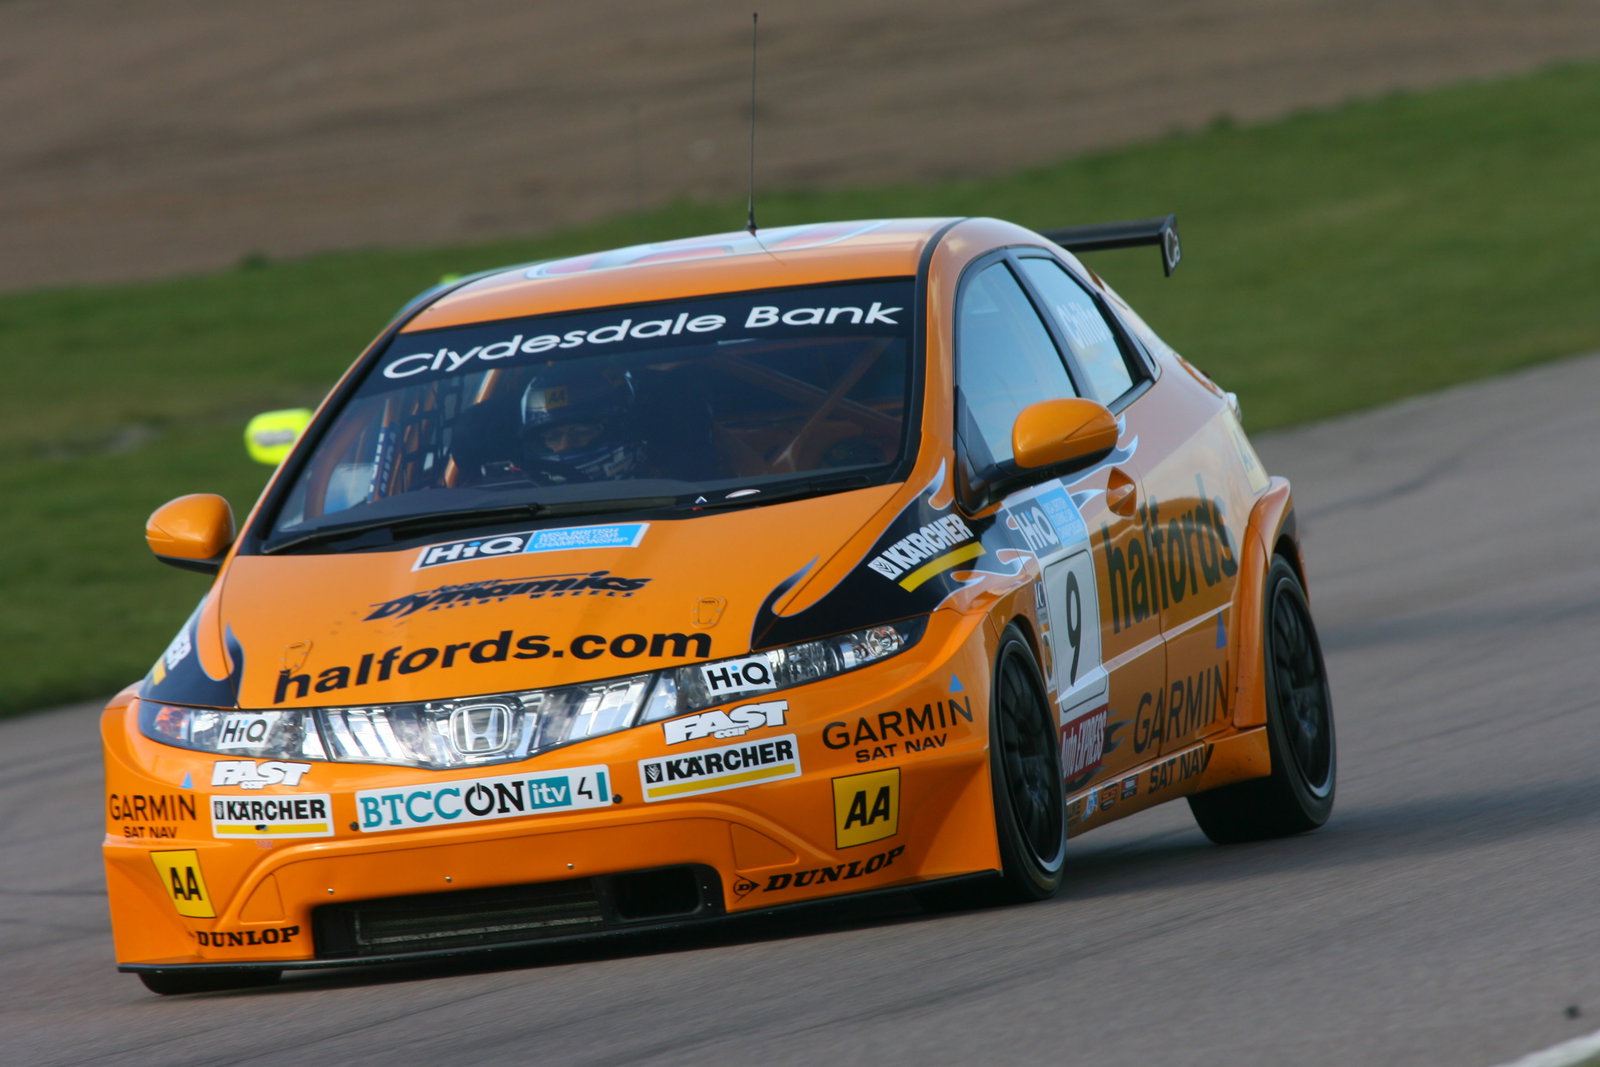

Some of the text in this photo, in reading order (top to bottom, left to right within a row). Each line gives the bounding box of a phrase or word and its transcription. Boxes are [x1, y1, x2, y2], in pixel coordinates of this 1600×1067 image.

[383, 302, 903, 379] Clydesdale Bank
[1014, 506, 1060, 551] HiQ
[425, 535, 524, 568] HiQ
[1101, 472, 1239, 634] halfords
[1066, 571, 1083, 688] 9
[273, 630, 713, 704] halfords.com
[707, 662, 771, 690] HiQ
[663, 700, 789, 745] FAST
[822, 696, 974, 750] GARMIN
[1134, 660, 1230, 754] GARMIN
[221, 719, 268, 743] HiQ
[856, 733, 947, 763] SAT NAV
[211, 760, 312, 786] FAST
[666, 740, 793, 780] KÄRCHER
[1148, 757, 1177, 794] SAT
[1179, 743, 1215, 782] NAV
[109, 794, 197, 821] GARMIN
[226, 799, 326, 820] KÄRCHER
[844, 786, 890, 830] AA
[124, 826, 177, 838] SAT NAV
[170, 867, 202, 900] AA
[763, 845, 906, 892] DUNLOP
[197, 926, 299, 947] DUNLOP
